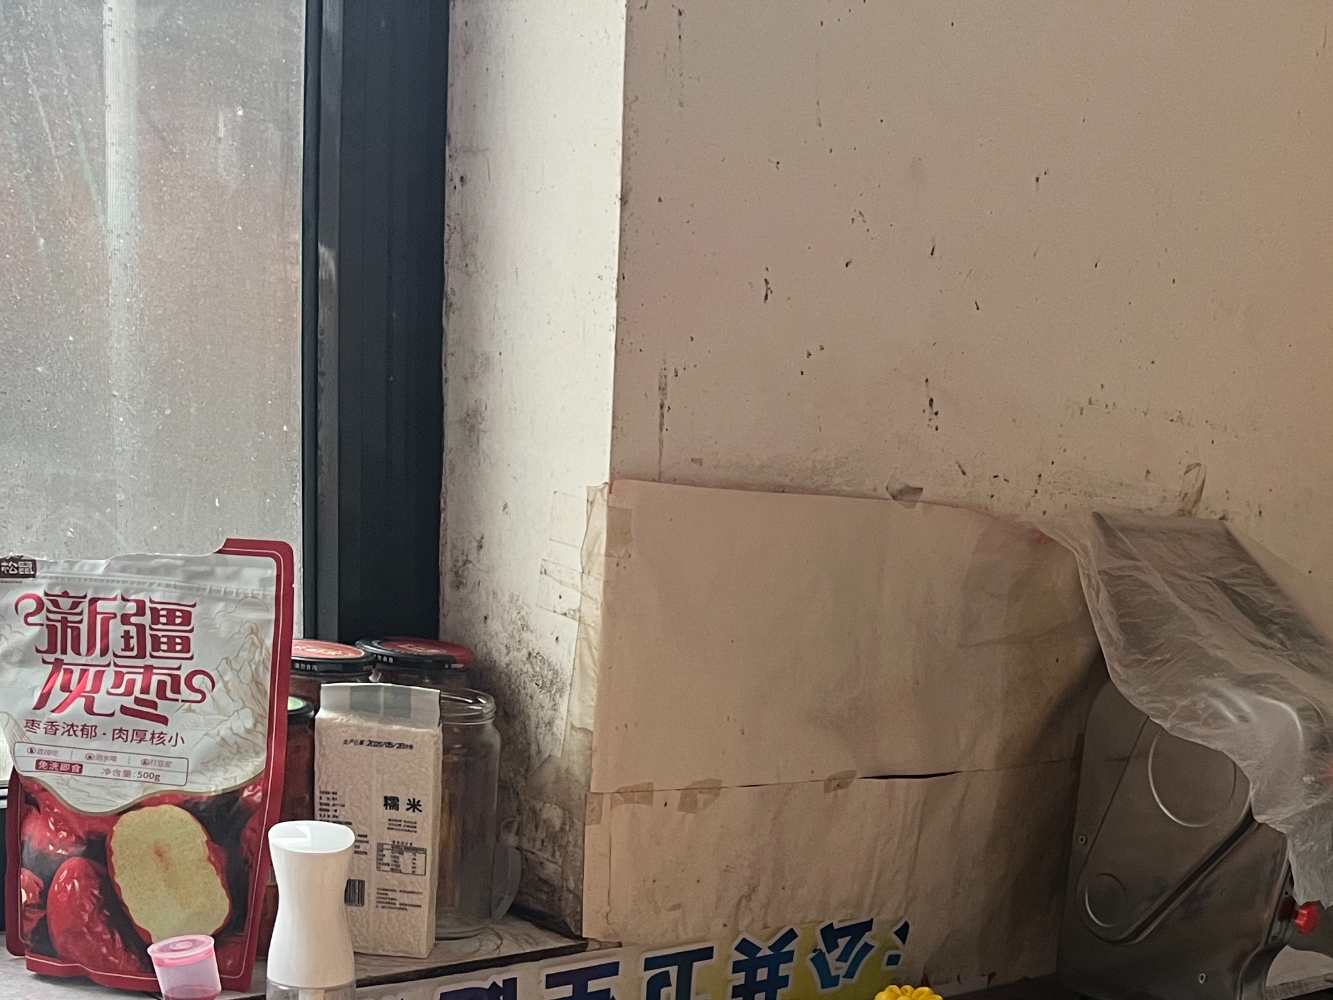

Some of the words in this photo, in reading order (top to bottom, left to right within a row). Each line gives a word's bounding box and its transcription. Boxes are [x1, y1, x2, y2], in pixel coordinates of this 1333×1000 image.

[1, 561, 35, 575] 松鼠
[14, 590, 197, 663] 新疆
[32, 656, 216, 727] 灰枣
[38, 761, 81, 773] 免洗即食
[383, 795, 423, 813] 糯米
